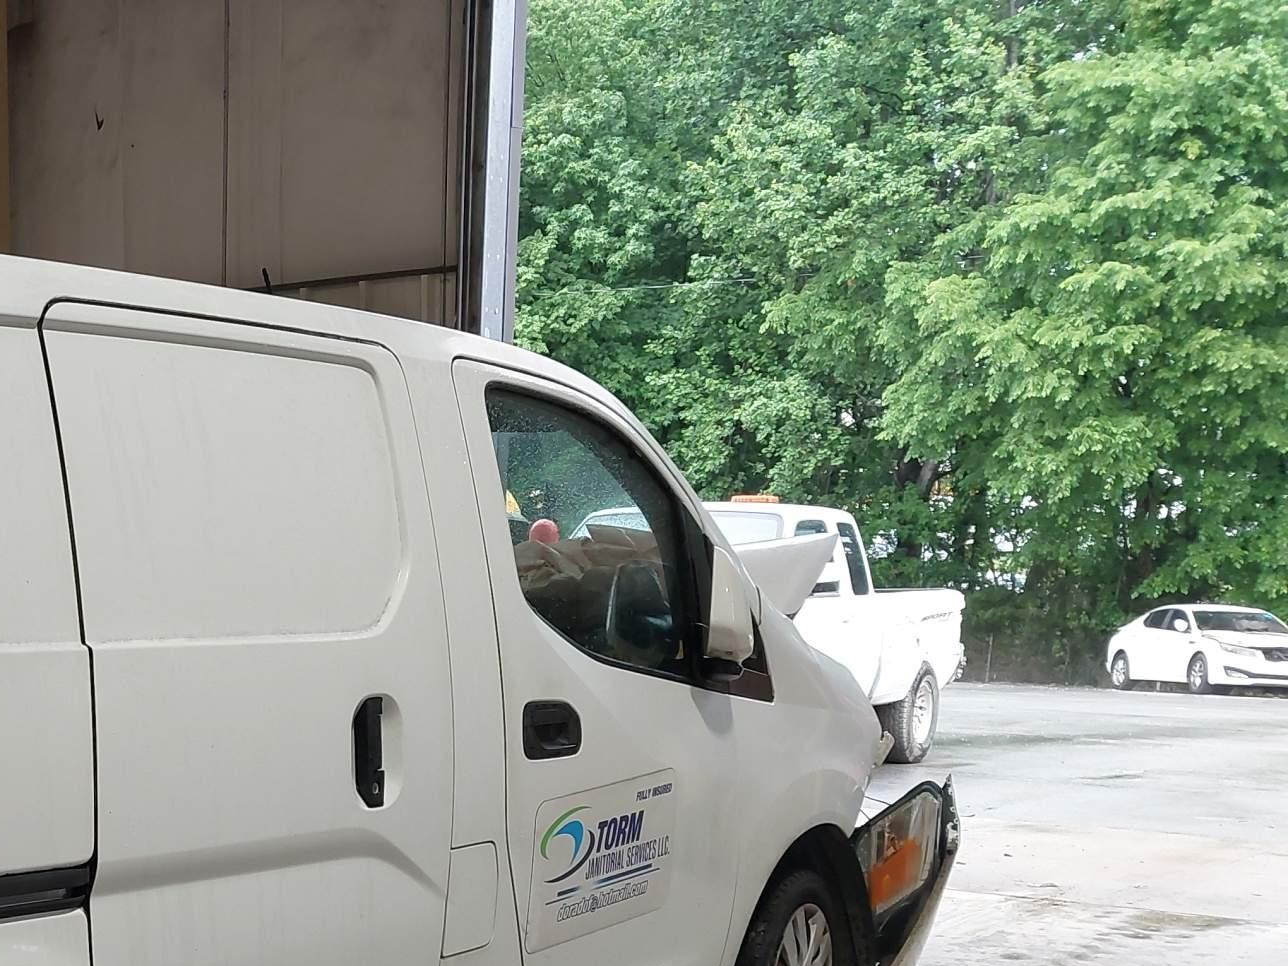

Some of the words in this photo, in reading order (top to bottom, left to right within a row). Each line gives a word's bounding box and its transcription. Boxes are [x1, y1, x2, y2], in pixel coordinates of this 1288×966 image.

[636, 788, 652, 801] FULLY
[651, 783, 673, 796] INSURED
[585, 848, 625, 880] JANITORIAL
[626, 840, 657, 867] SERVICES
